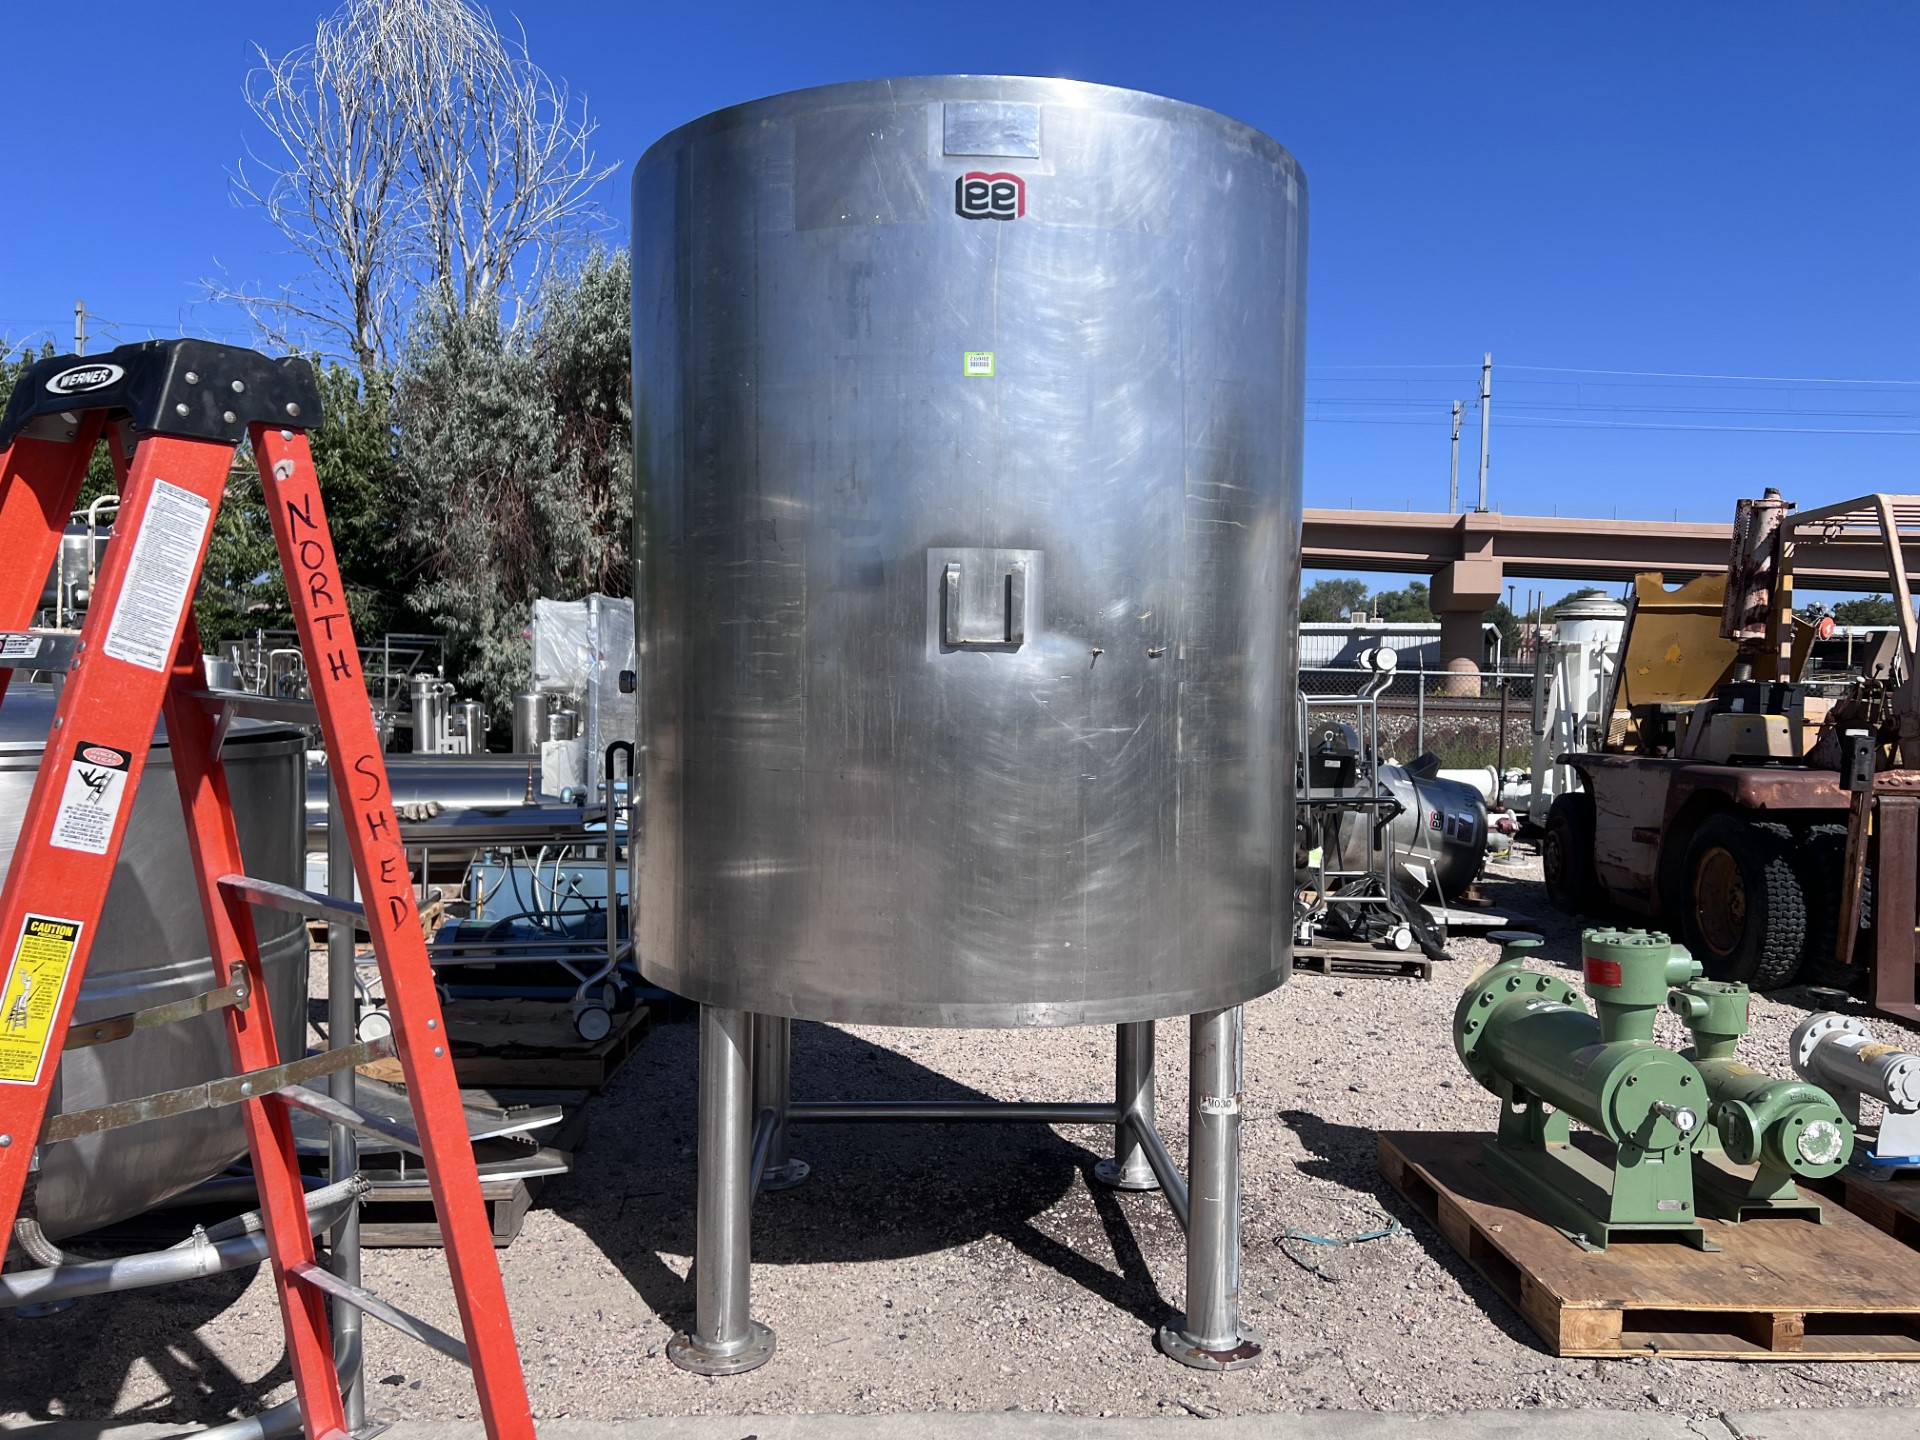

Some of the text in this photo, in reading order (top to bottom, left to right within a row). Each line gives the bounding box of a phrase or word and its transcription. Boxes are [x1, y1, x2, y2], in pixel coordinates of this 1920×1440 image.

[59, 369, 110, 388] WERNER
[287, 493, 409, 932] NORTH SHED
[30, 921, 74, 937] CAUTION
